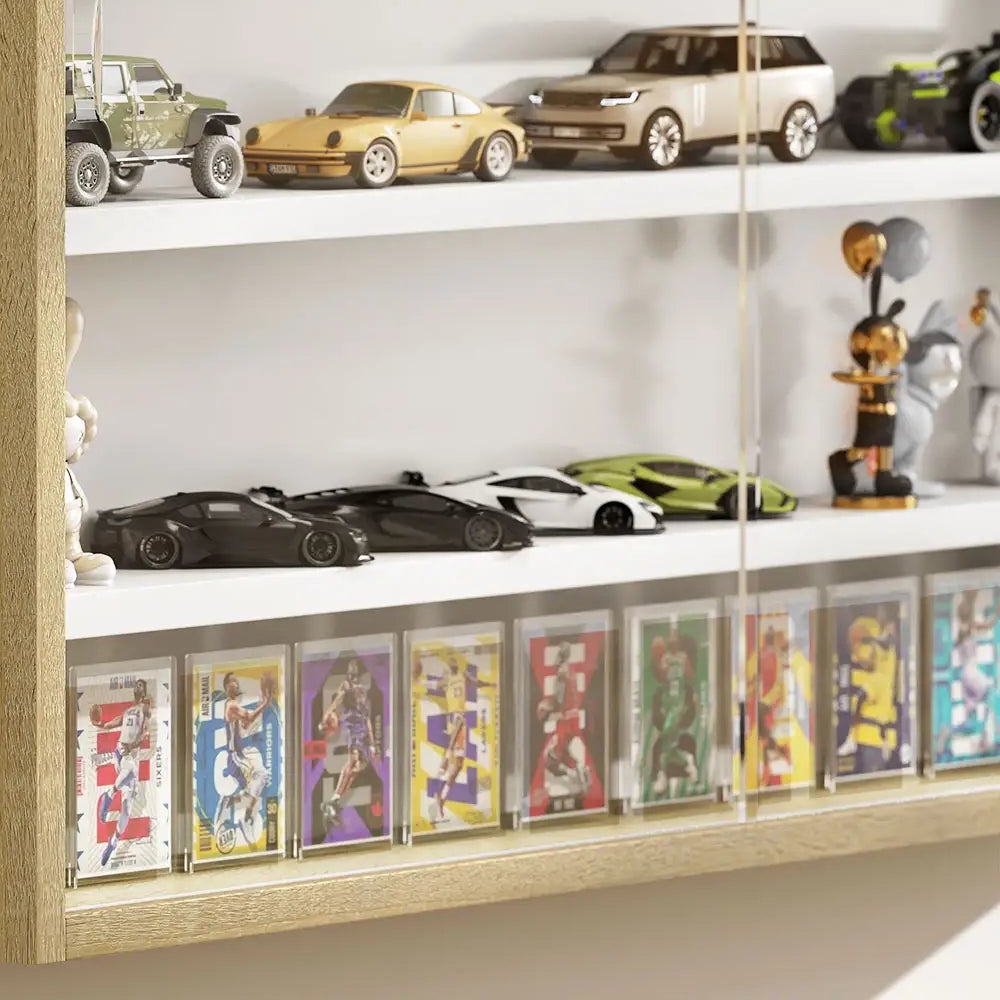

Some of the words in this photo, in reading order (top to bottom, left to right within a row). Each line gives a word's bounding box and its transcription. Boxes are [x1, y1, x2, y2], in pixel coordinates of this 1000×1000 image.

[201, 675, 210, 696] MAIL
[200, 702, 210, 717] AIR
[155, 745, 163, 788] SIXERS
[264, 722, 274, 788] WARRIORS
